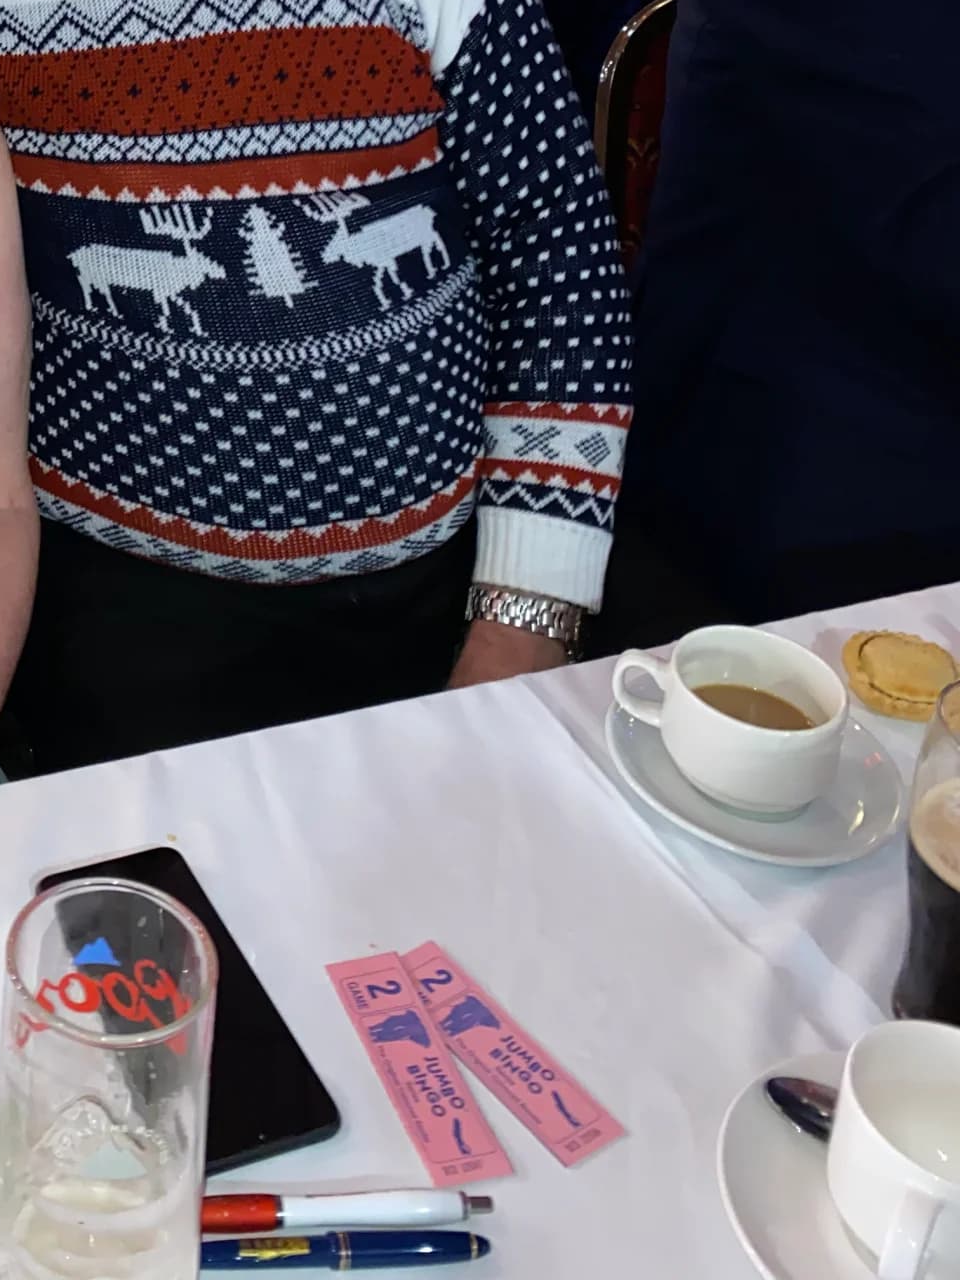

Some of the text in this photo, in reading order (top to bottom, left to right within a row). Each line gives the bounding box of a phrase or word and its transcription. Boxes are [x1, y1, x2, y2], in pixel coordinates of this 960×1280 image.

[347, 981, 370, 1010] GAME
[367, 980, 402, 1000] 2
[421, 970, 453, 993] 2
[489, 1048, 543, 1095] BINGO
[500, 1035, 556, 1082] JUMBO
[407, 1065, 446, 1117] BINGO
[423, 1056, 465, 1110] JUMBO
